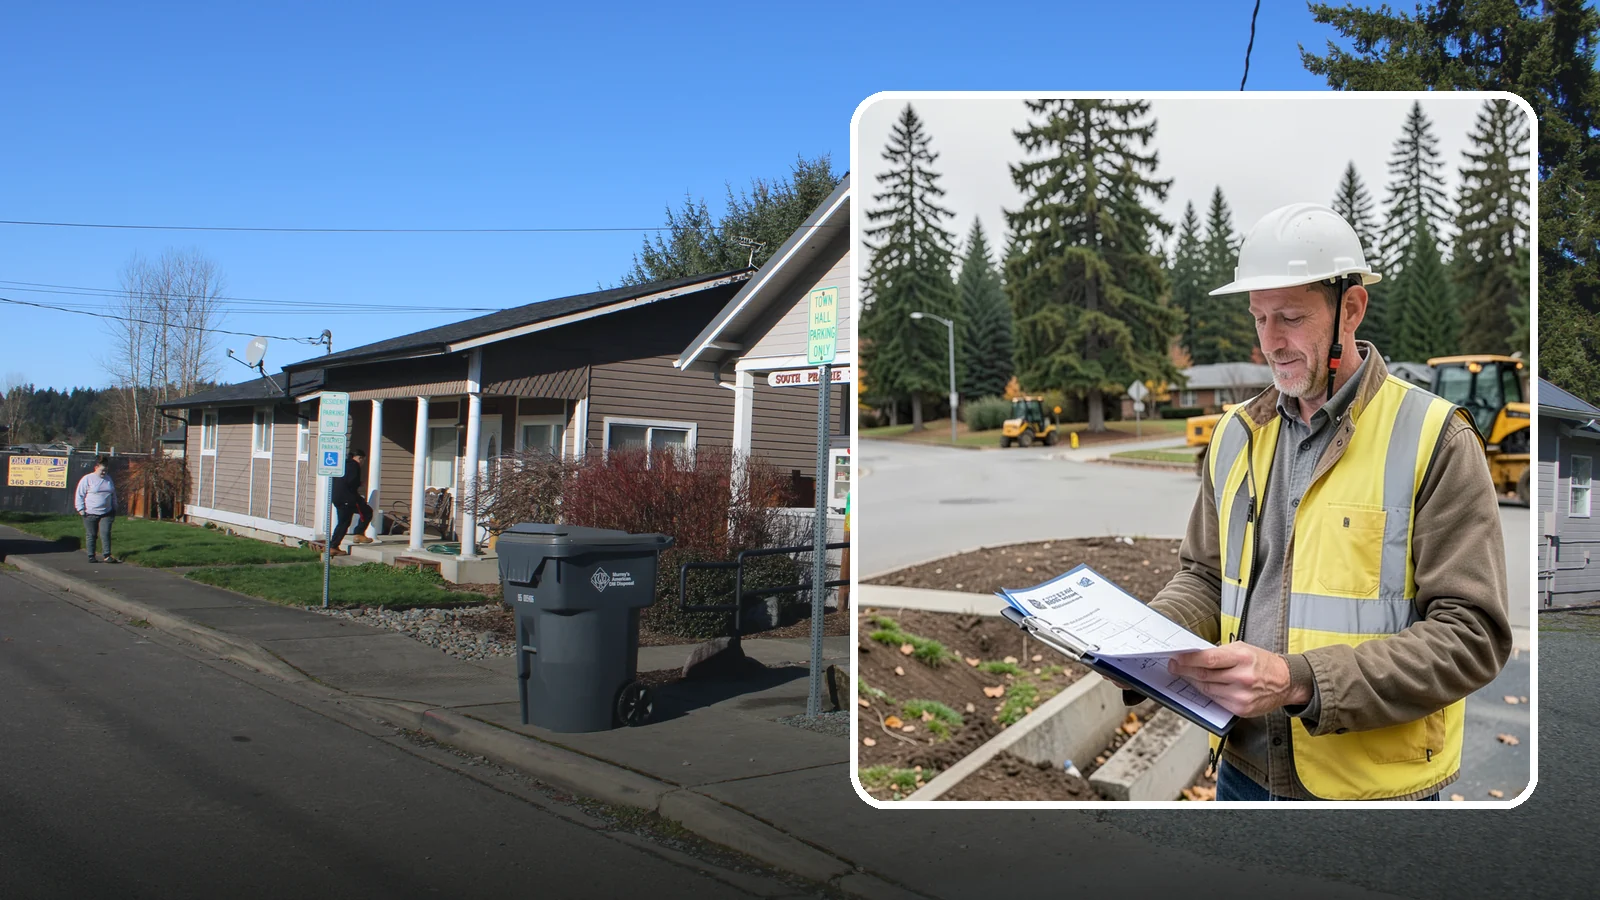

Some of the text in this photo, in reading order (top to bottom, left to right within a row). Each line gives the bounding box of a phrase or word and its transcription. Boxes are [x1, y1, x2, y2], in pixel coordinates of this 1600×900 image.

[815, 294, 833, 308] TOWN
[814, 311, 831, 324] HALL
[809, 326, 835, 341] PARKING
[813, 344, 830, 357] ONLY
[775, 373, 801, 384] SOUTH
